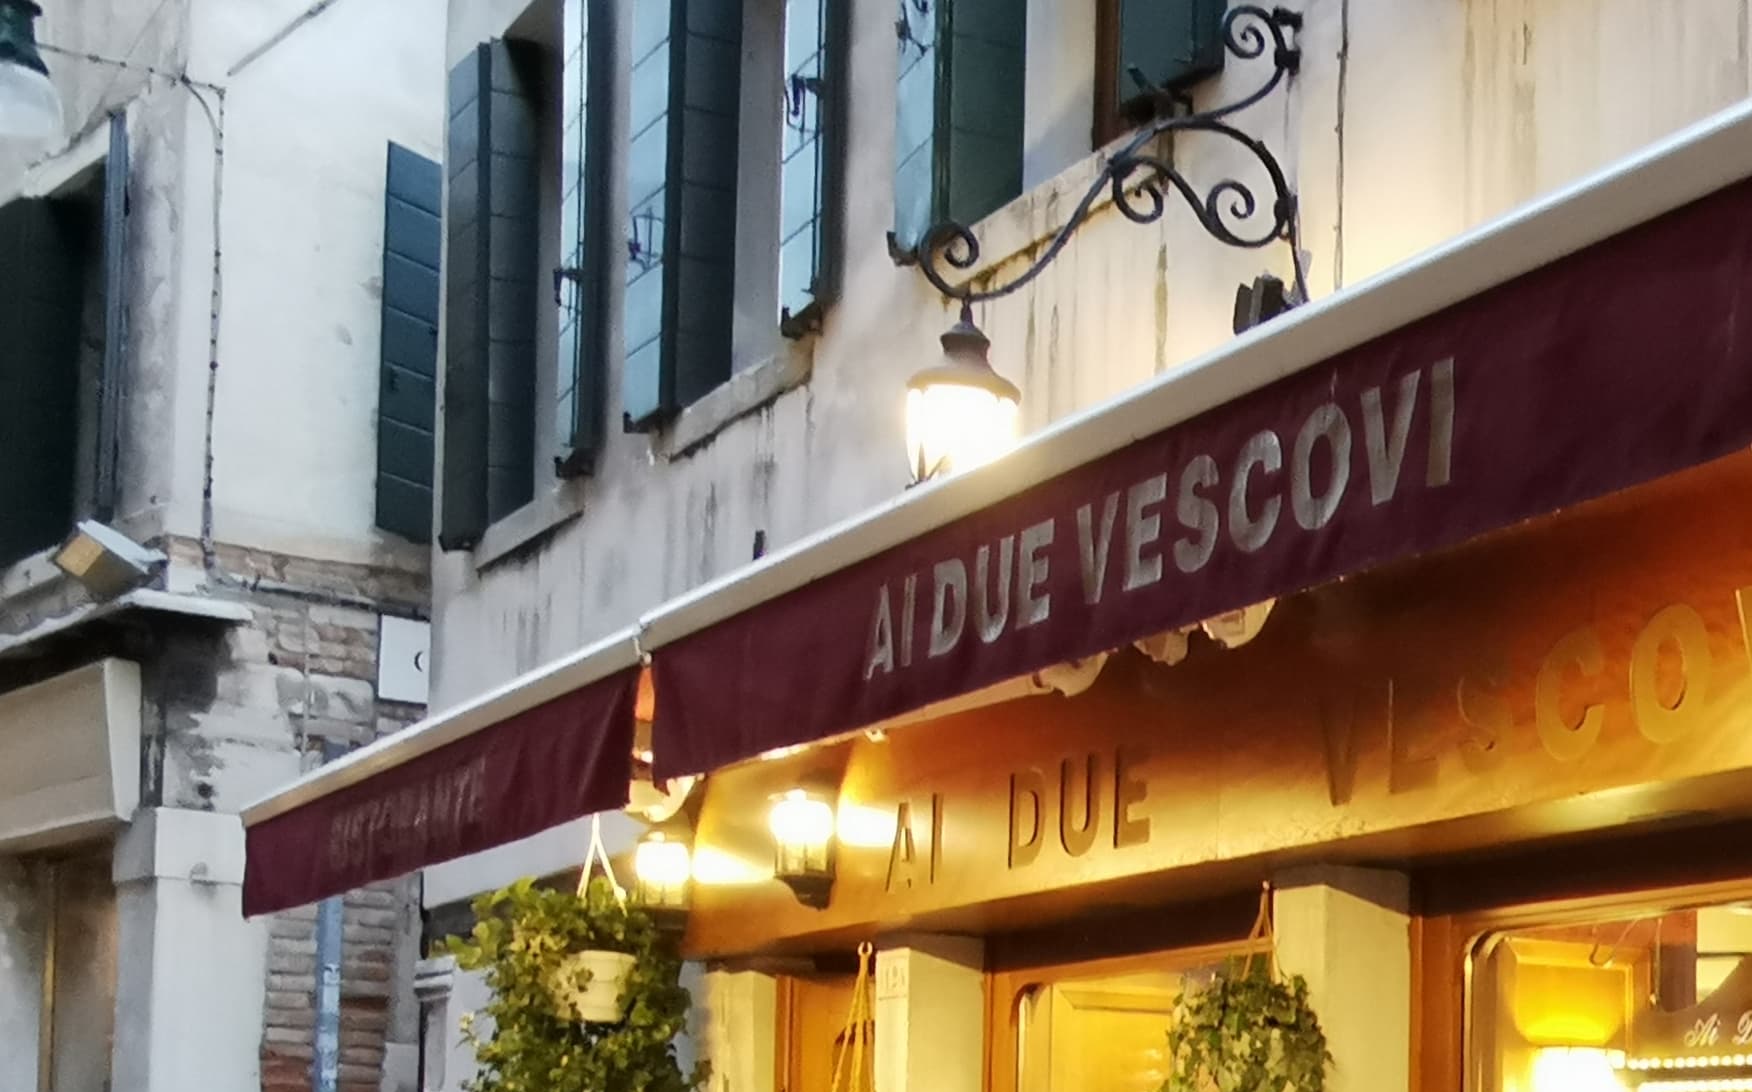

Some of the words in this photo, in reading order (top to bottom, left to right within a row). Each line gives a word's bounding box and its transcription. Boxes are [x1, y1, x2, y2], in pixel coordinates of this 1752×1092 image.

[864, 572, 918, 682] AI
[928, 517, 1056, 660] DUE
[1076, 357, 1456, 606] VESCOVI
[886, 792, 944, 893] AI
[1008, 744, 1151, 871] DUE
[1684, 1012, 1722, 1048] Ai
